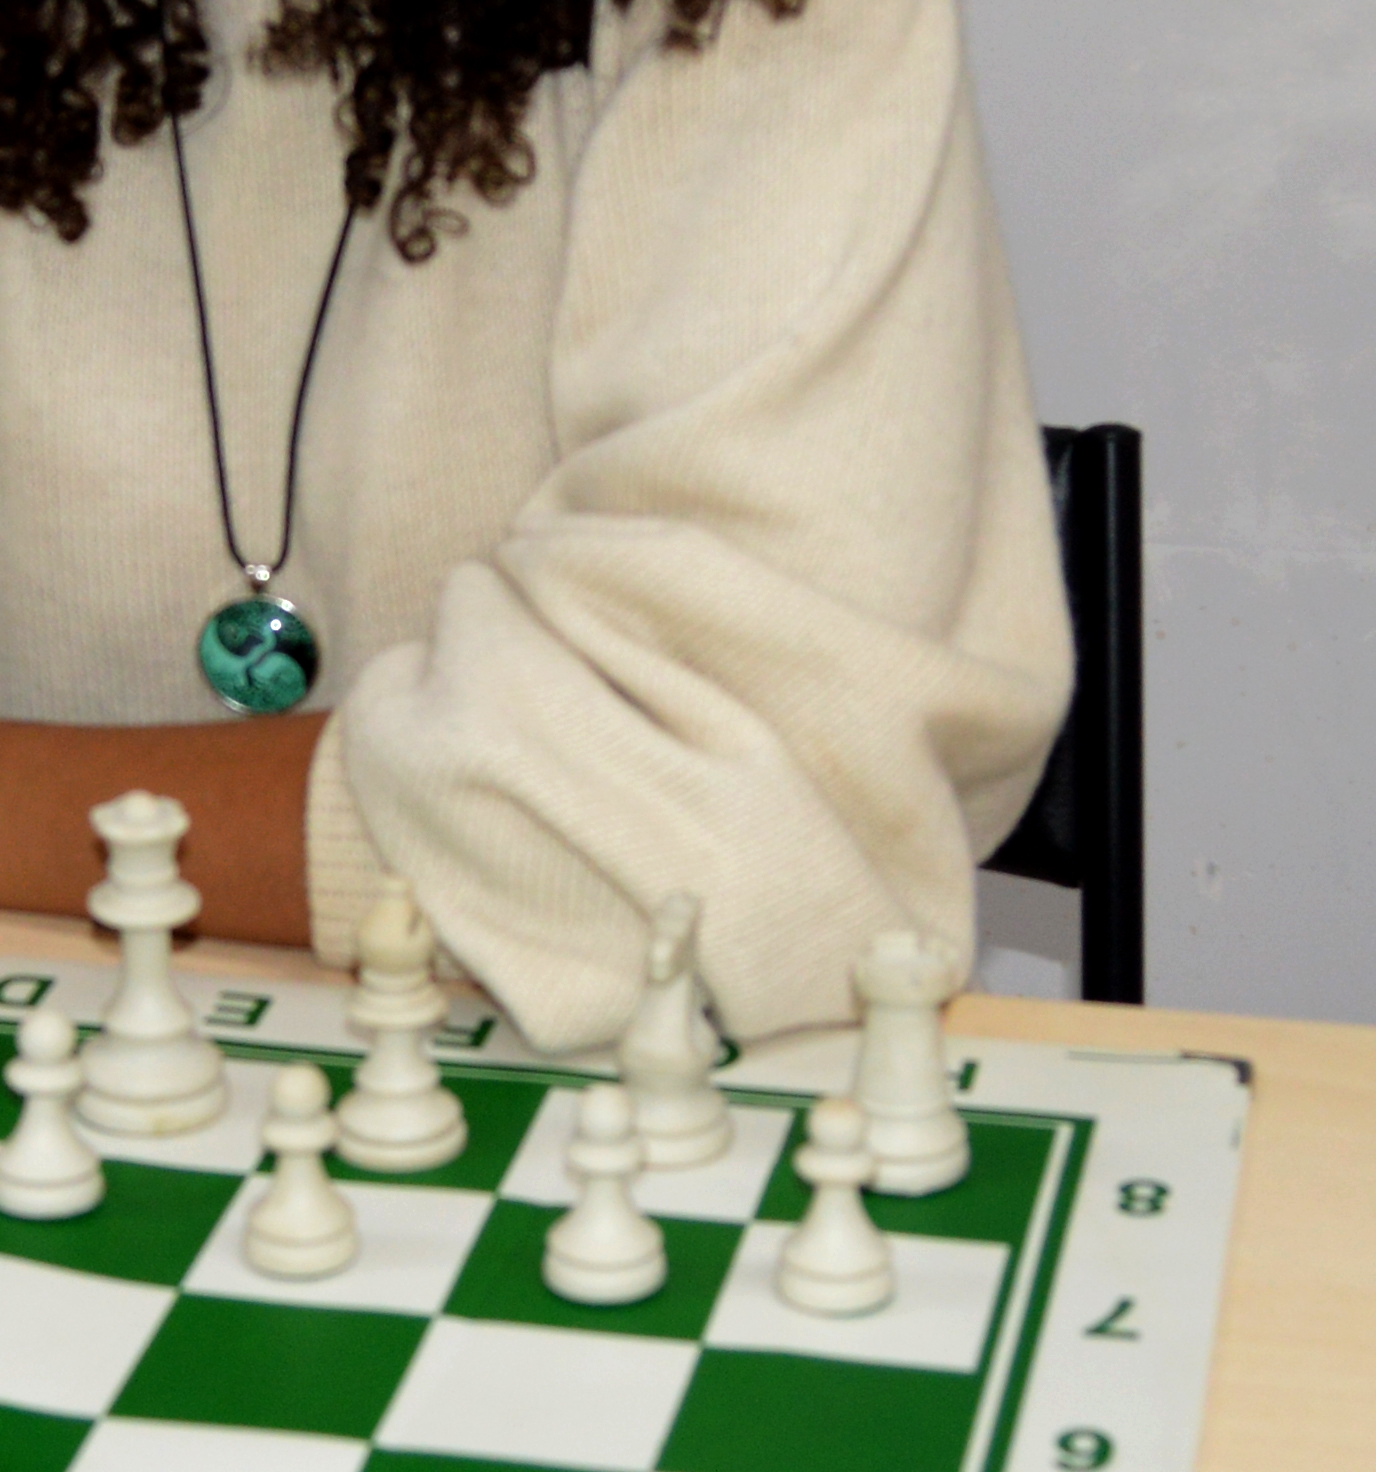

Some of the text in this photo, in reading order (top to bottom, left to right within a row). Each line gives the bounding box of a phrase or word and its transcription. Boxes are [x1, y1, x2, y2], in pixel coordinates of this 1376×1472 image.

[205, 990, 271, 1028] E
[1116, 1179, 1170, 1218] 8
[1084, 1294, 1140, 1340] 7
